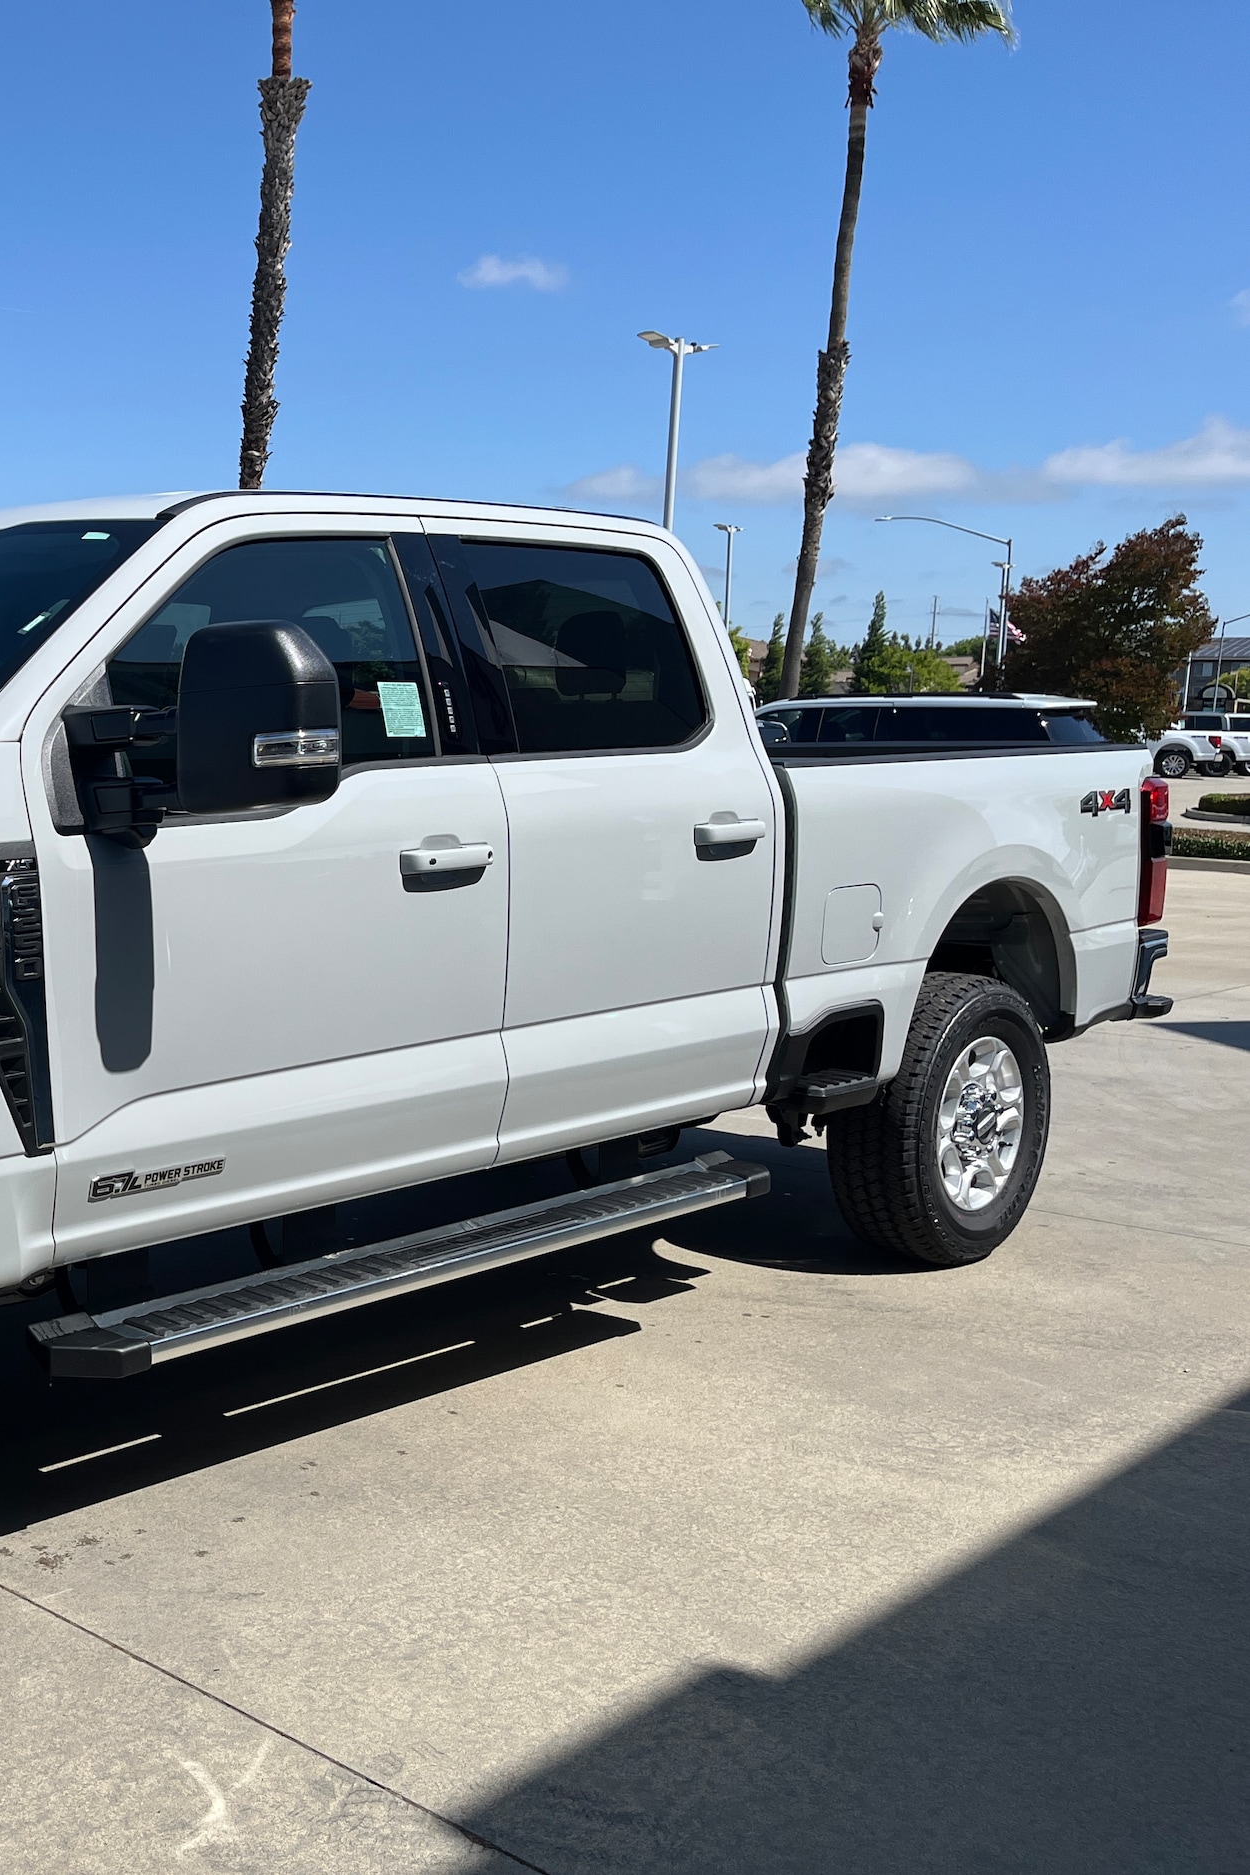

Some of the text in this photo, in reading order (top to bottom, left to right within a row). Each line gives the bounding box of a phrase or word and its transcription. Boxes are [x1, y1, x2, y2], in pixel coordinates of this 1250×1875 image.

[91, 1159, 224, 1198] 6.7L POWER STROKE
